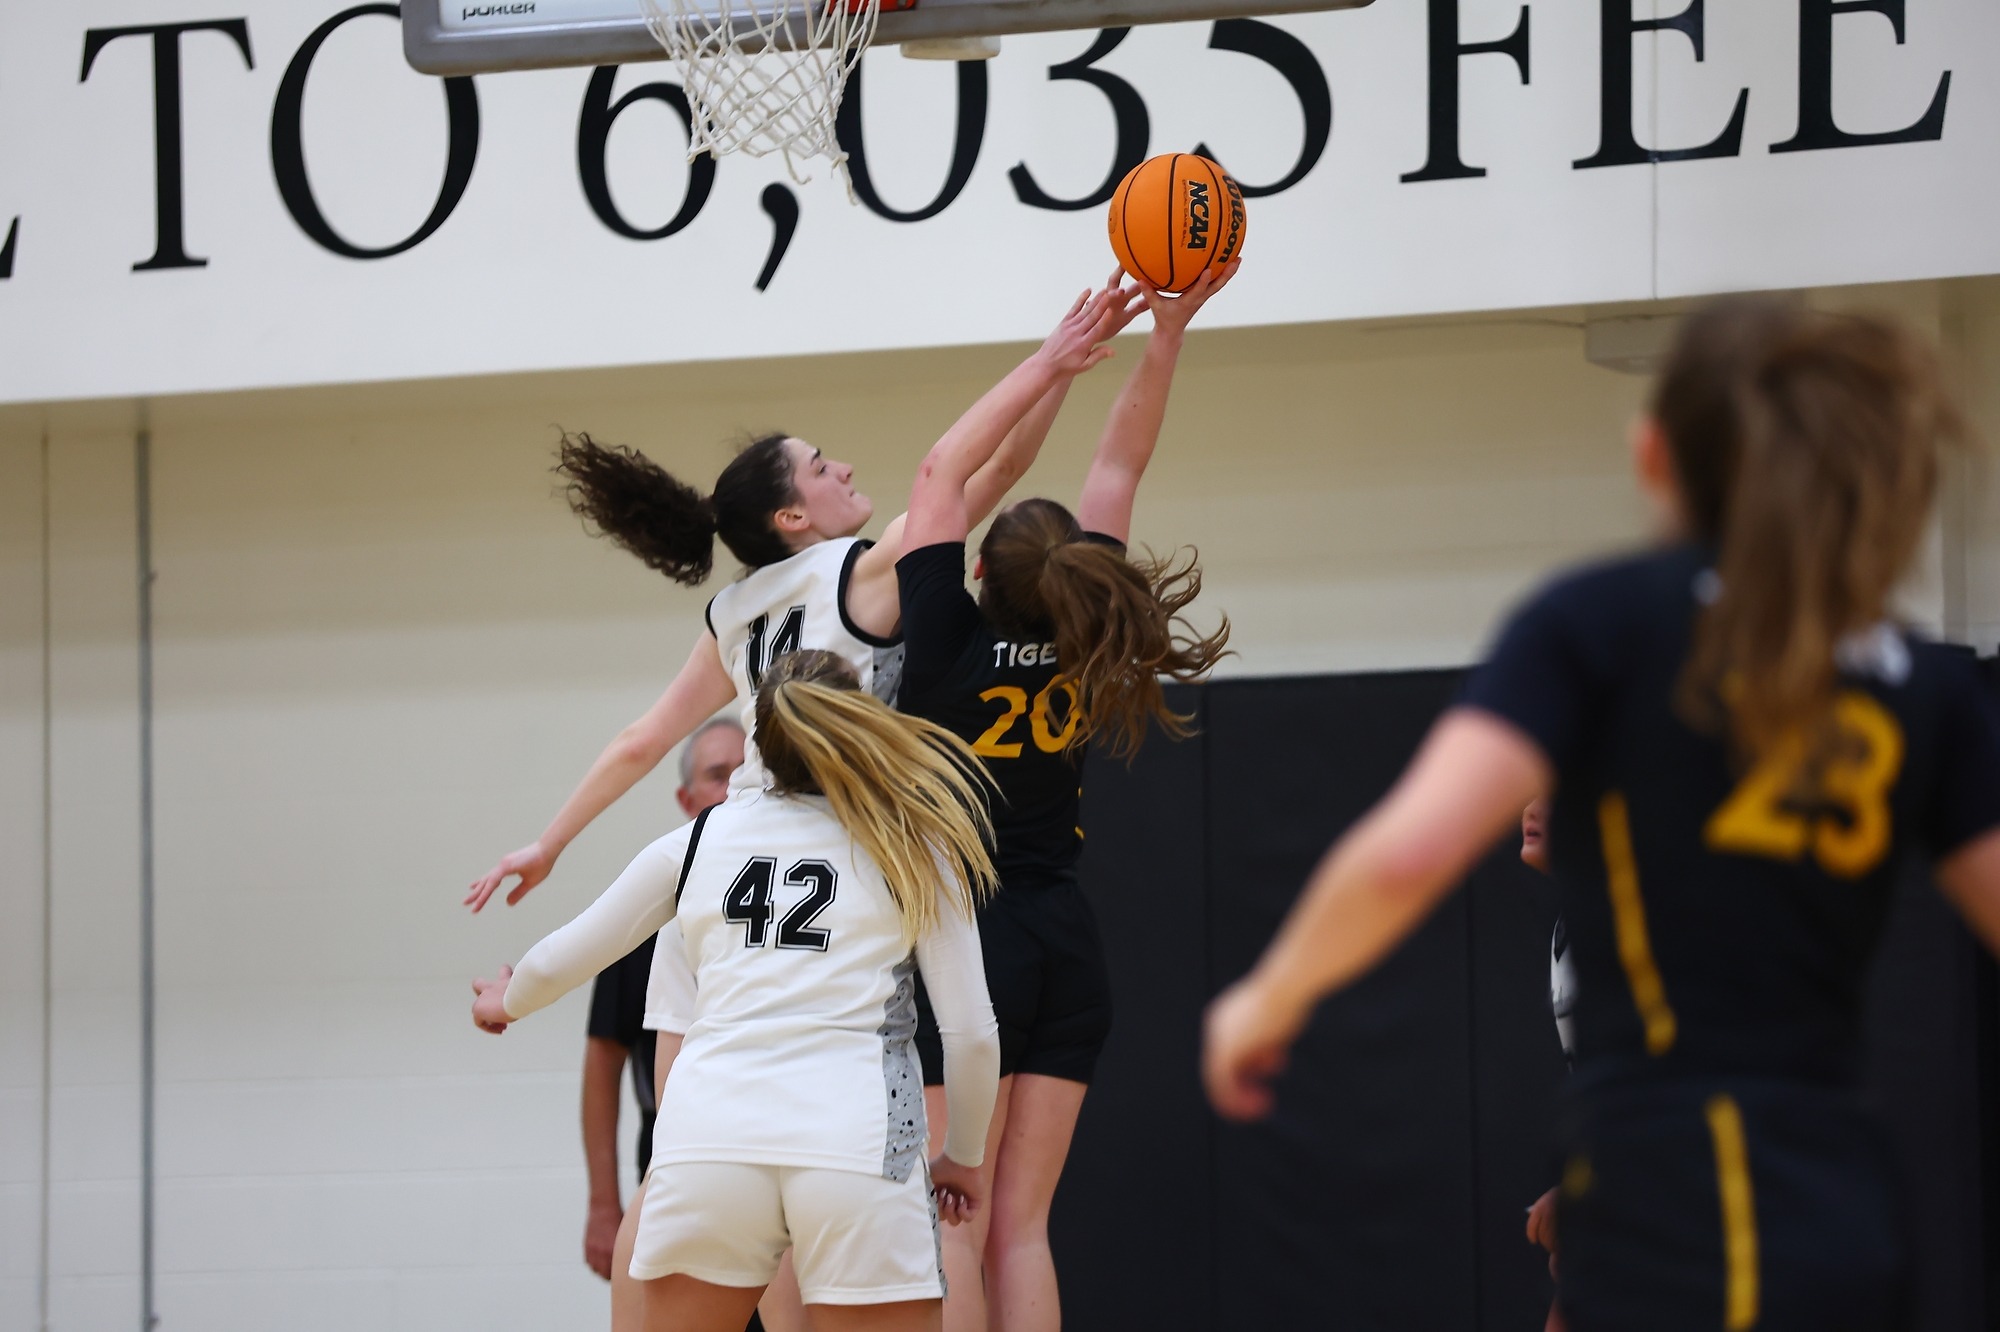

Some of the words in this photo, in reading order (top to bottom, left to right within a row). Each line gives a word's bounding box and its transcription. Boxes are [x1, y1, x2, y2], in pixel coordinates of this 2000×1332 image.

[78, 3, 480, 272] TO
[577, 18, 1332, 293] 6,035
[1400, 0, 1952, 183] FEE
[1187, 179, 1210, 250] NCAA
[993, 641, 1057, 668] TIGE
[970, 673, 1082, 759] 20
[1706, 688, 1905, 880] 23
[723, 856, 839, 952] 42
